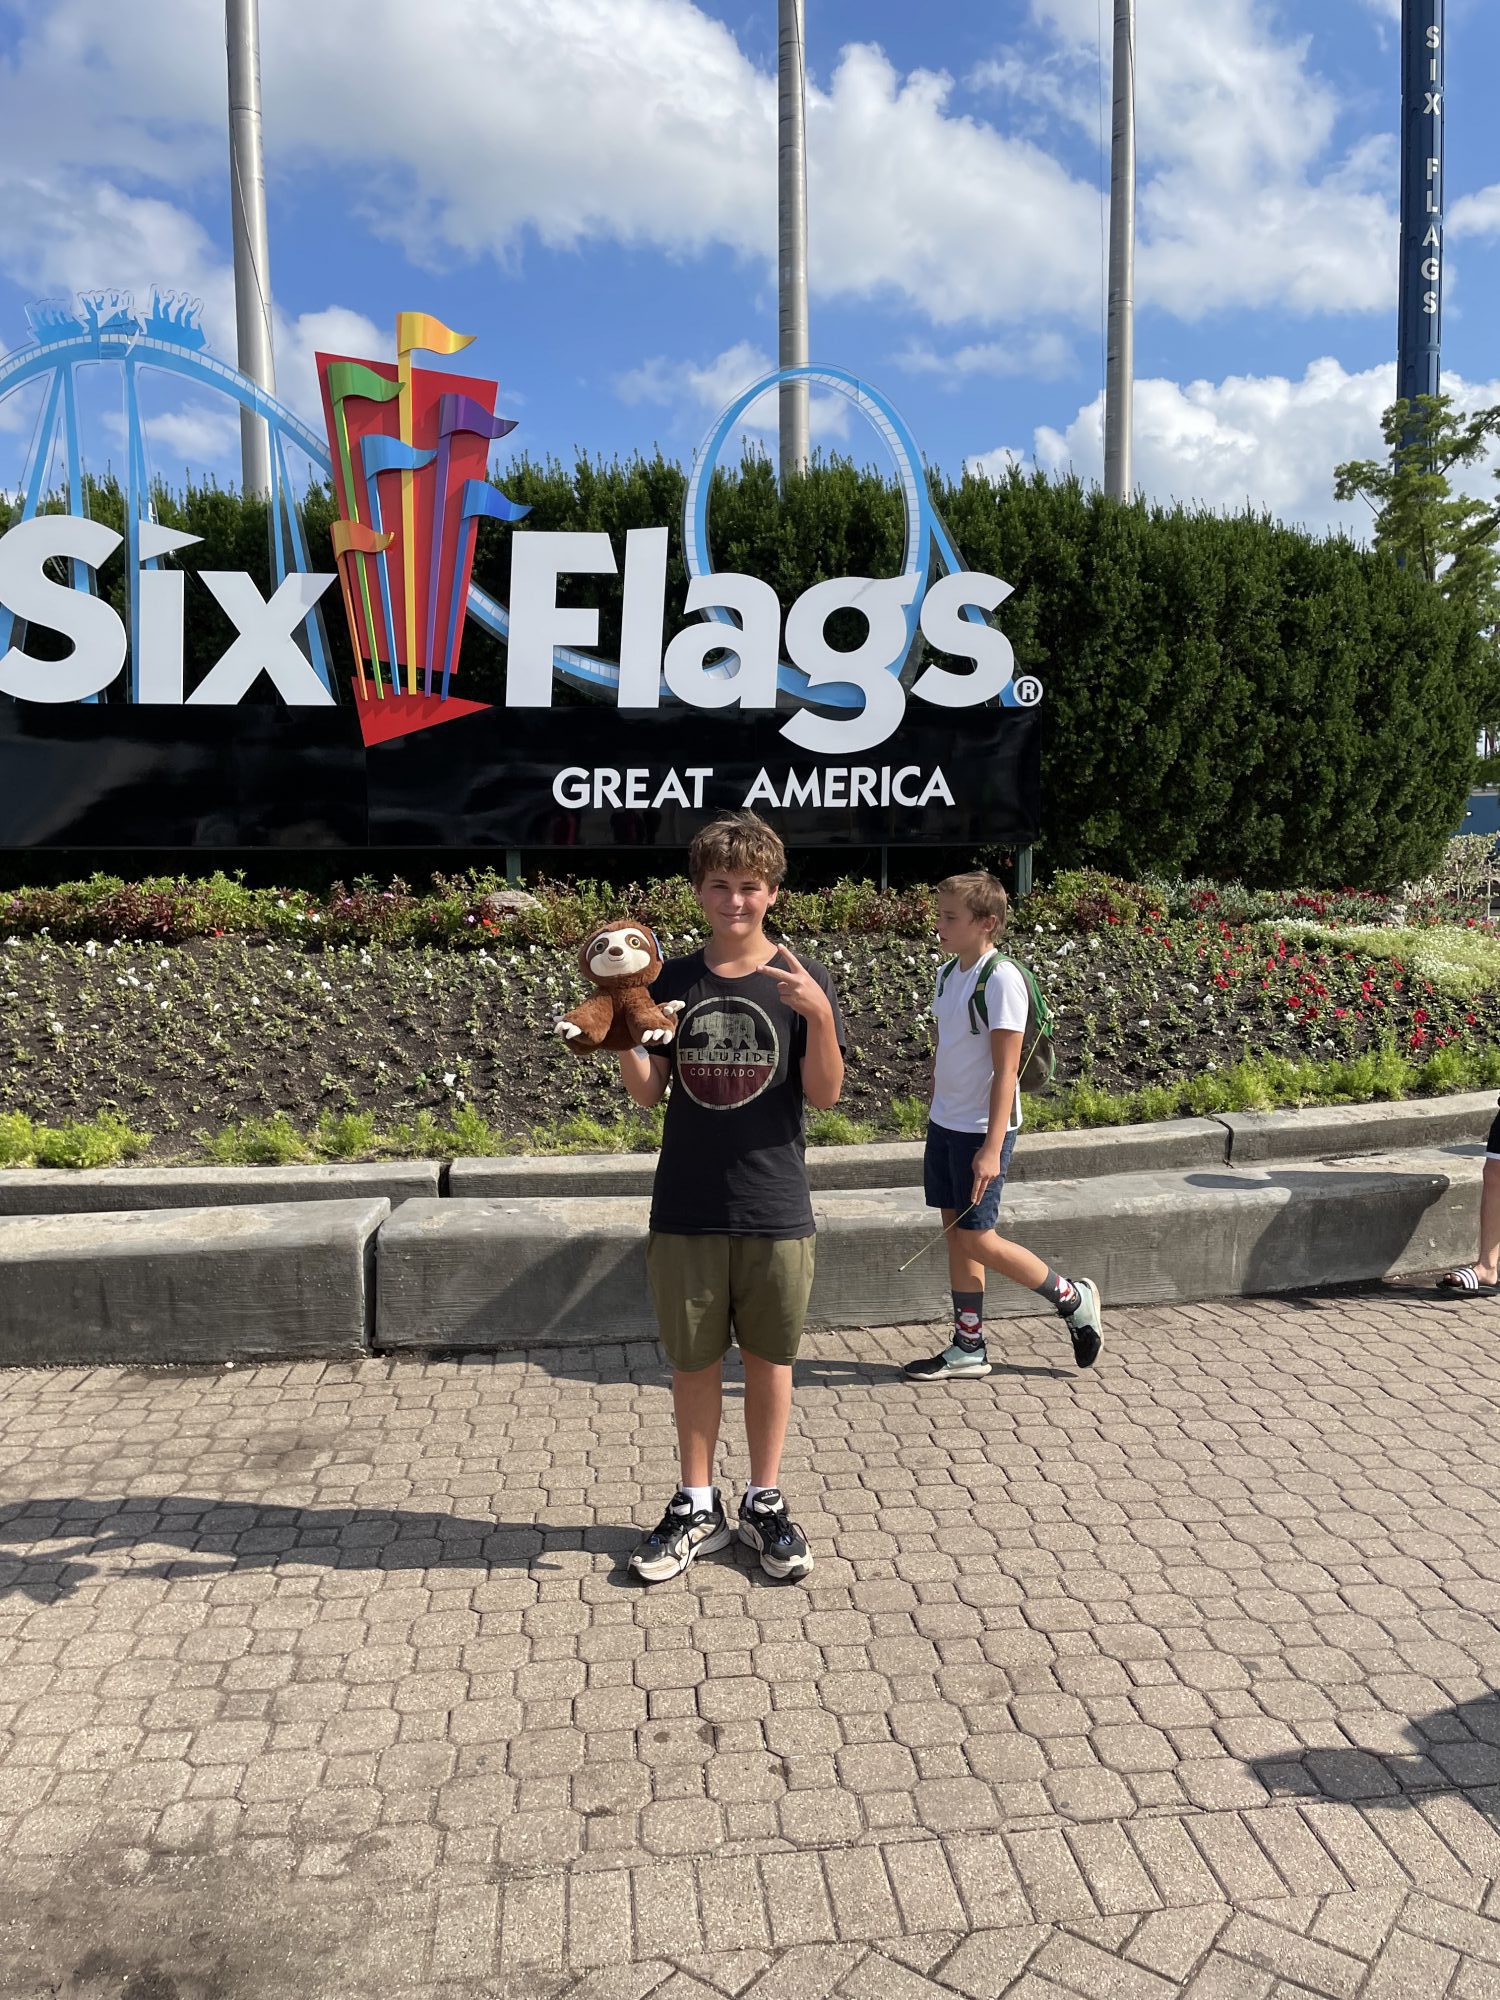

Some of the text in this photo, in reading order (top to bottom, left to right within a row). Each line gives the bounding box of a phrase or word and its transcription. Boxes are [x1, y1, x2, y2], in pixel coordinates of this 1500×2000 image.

[1421, 25, 1440, 315] SIX FLAGS
[0, 514, 339, 707] Six
[505, 526, 1015, 754] Flags
[552, 765, 956, 809] GREAT AMERICA
[679, 1051, 775, 1064] TELLURIDE
[689, 1067, 755, 1078] COLORADO
